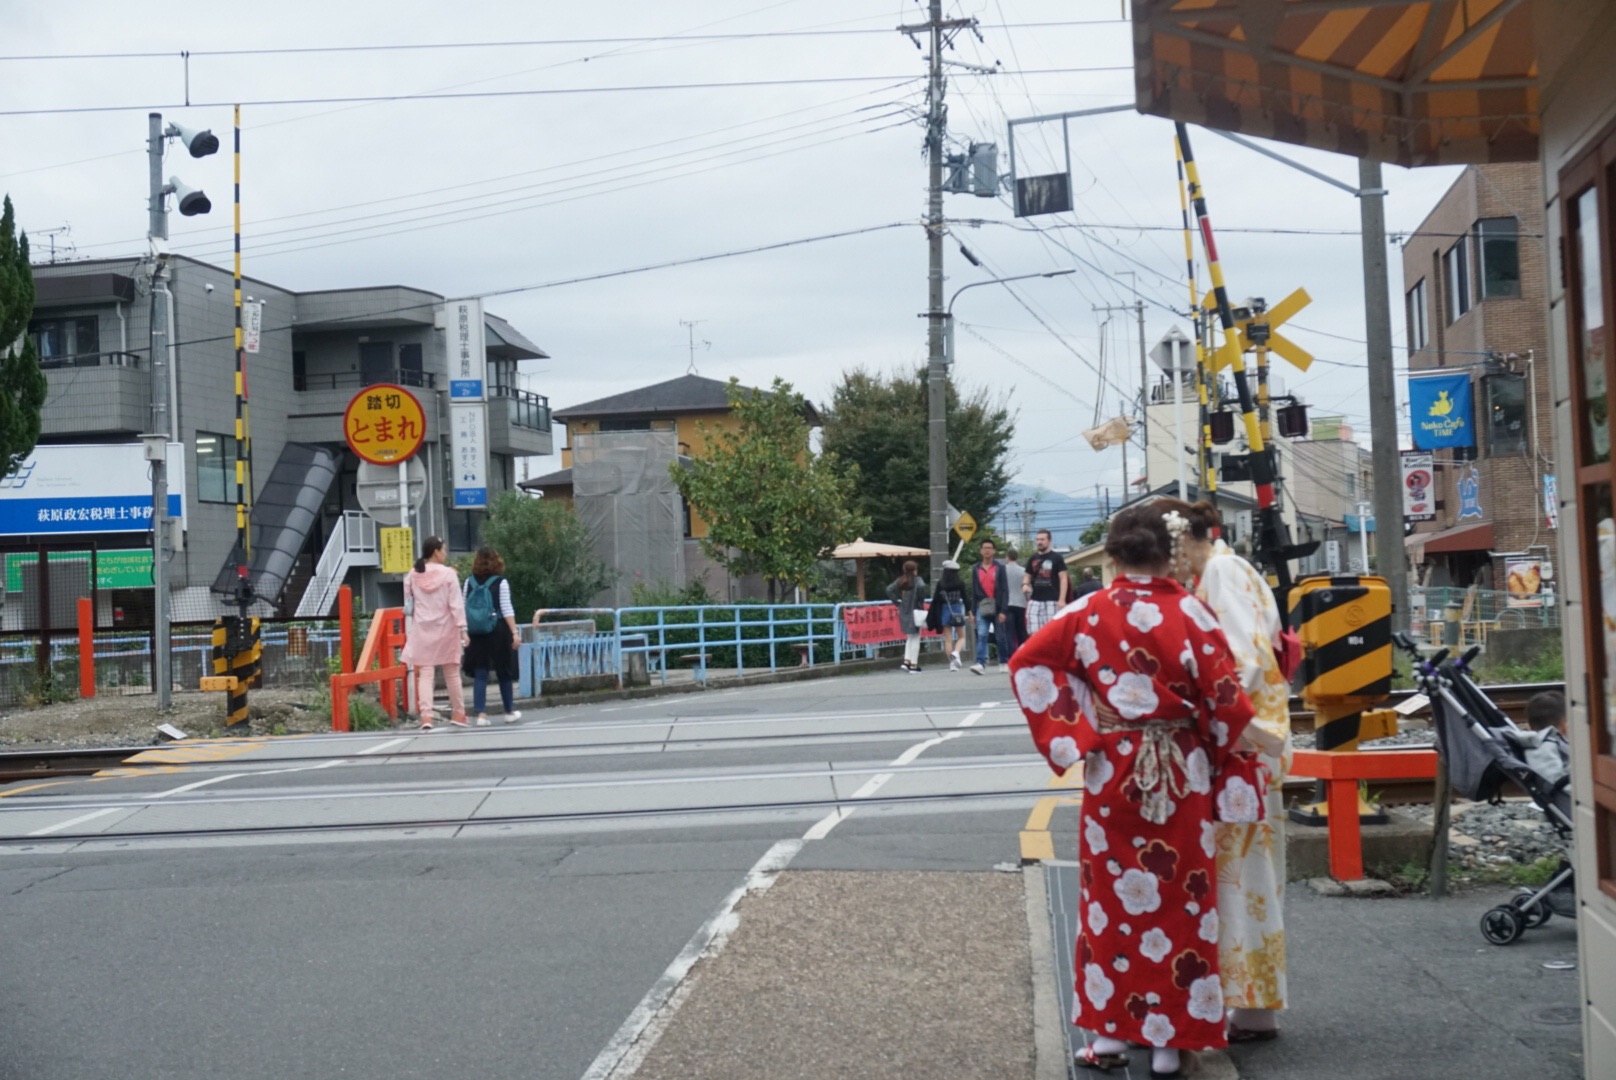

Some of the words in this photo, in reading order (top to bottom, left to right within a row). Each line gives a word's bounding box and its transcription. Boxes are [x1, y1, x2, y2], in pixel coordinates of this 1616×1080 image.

[458, 305, 470, 377] 萩原税理士事務所
[367, 394, 401, 410] 踏切
[352, 415, 419, 443] とまれ
[1421, 421, 1443, 430] Neko
